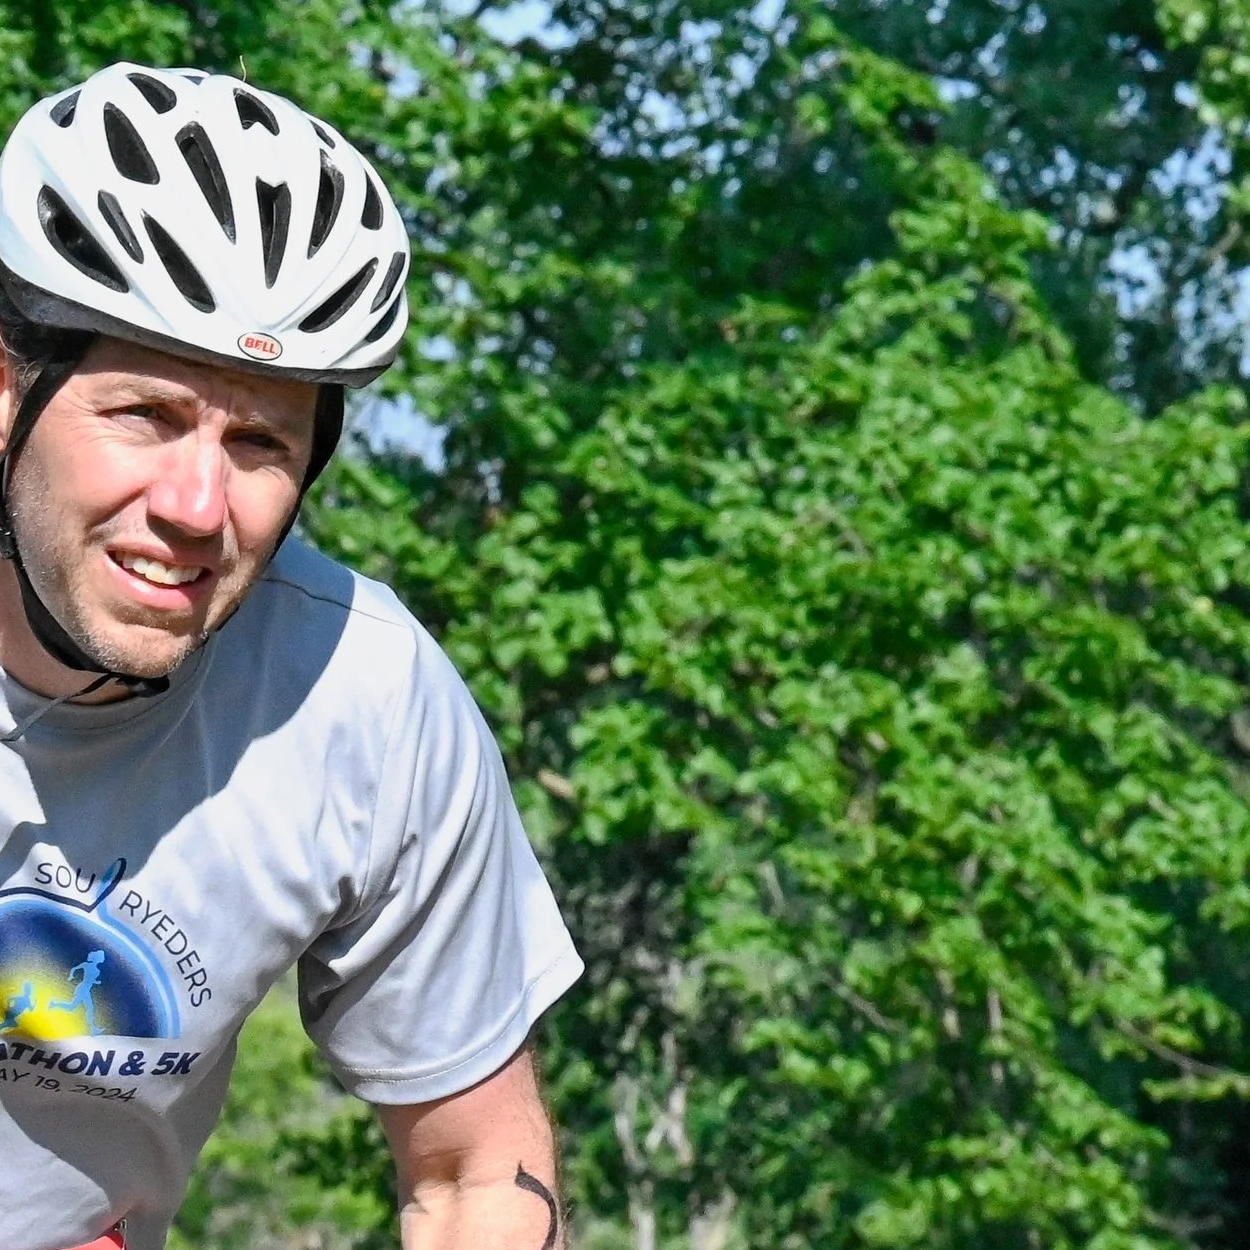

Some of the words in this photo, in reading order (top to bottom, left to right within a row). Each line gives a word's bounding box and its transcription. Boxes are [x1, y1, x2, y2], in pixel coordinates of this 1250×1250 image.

[244, 337, 275, 354] BELL
[119, 890, 212, 1007] RYEDERS
[118, 1050, 147, 1077] &
[150, 1052, 201, 1076] 5K
[34, 1075, 61, 1093] 19,
[68, 1084, 138, 1102] 2024
